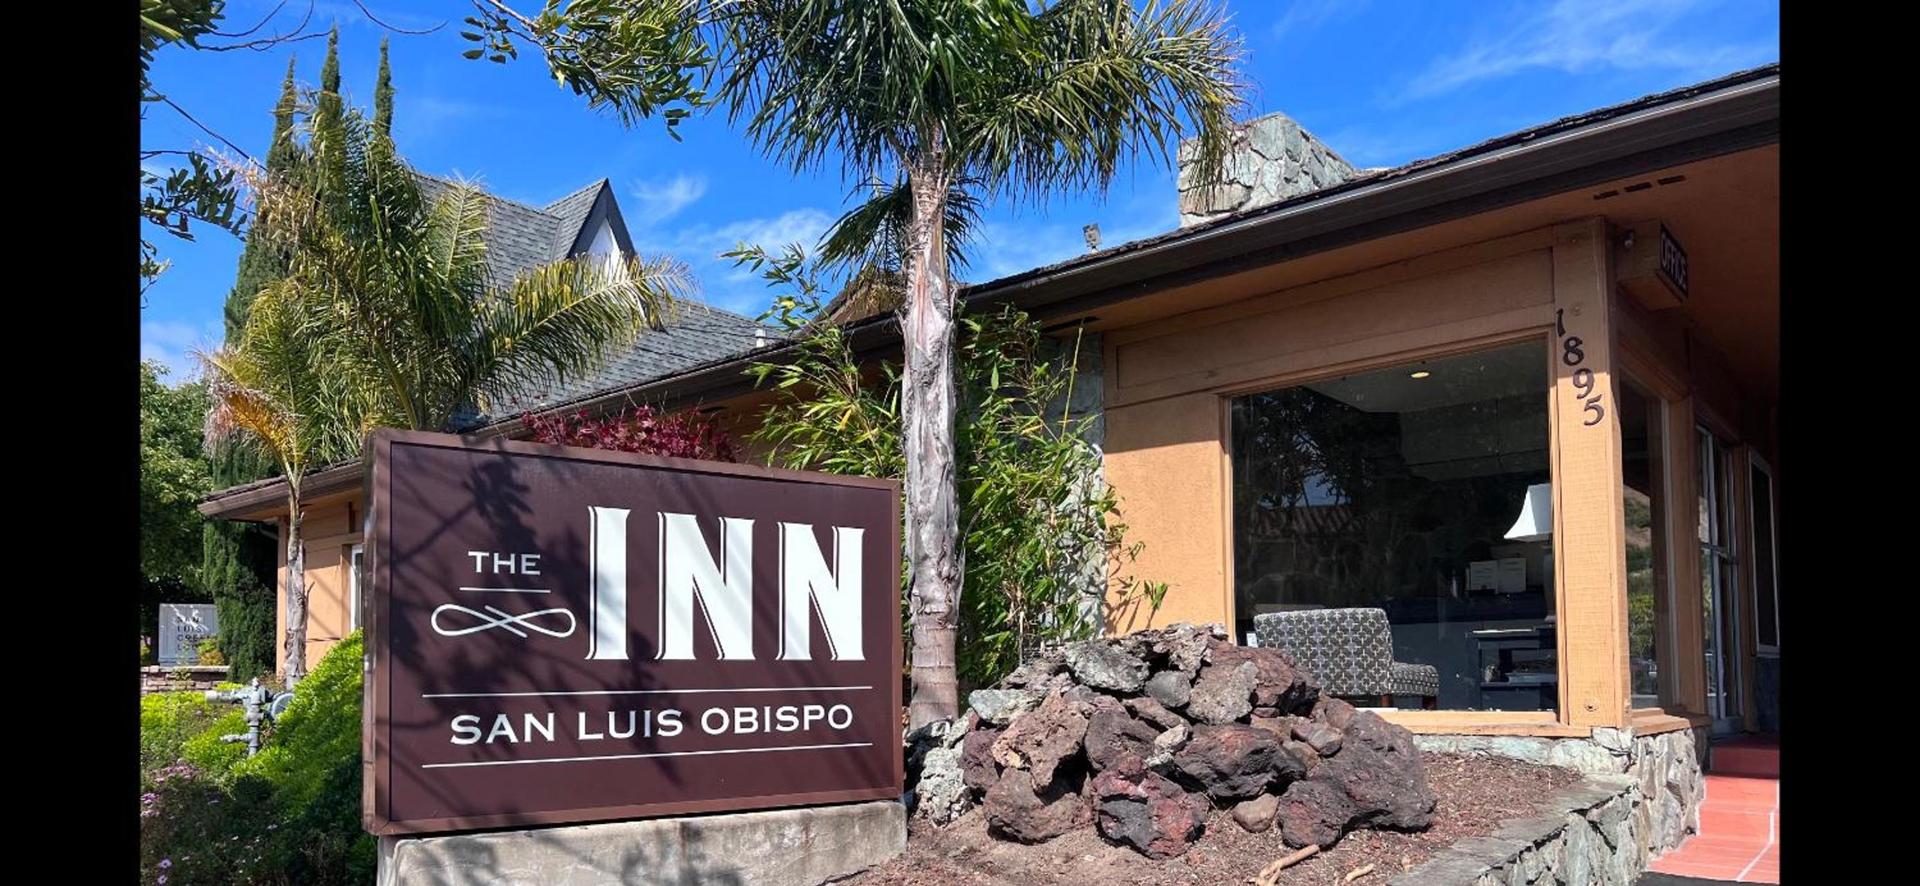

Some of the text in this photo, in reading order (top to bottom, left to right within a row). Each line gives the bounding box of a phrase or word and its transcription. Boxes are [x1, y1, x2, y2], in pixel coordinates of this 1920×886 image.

[1661, 232, 1687, 289] OFFICE
[1556, 308, 1605, 426] 1895
[467, 505, 866, 661] THE INN
[450, 704, 853, 745] SAN LUIS OBISPO
